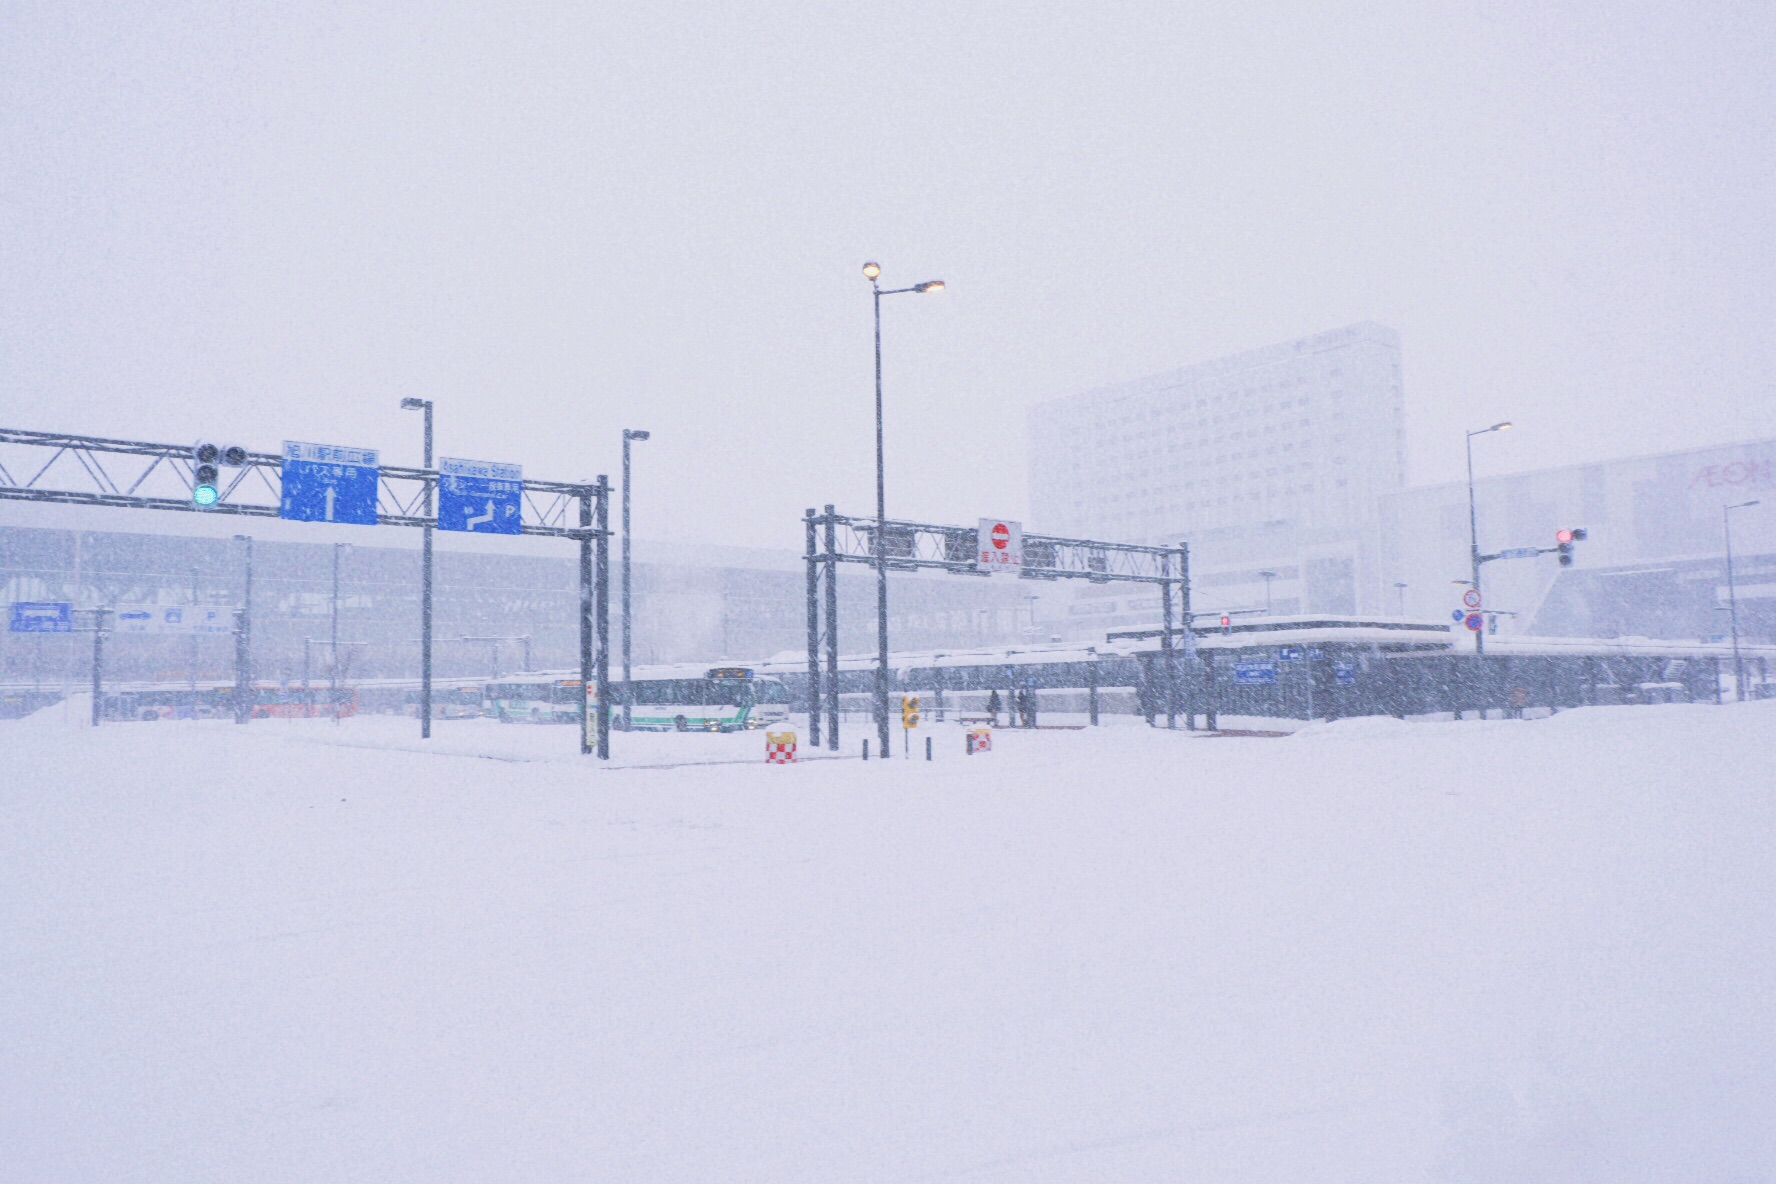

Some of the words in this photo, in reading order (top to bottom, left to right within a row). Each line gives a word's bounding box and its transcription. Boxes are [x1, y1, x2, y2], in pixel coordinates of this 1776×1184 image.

[286, 443, 377, 466] 旭川駅前広場
[505, 503, 516, 518] P
[980, 551, 1020, 565] 進入禁止
